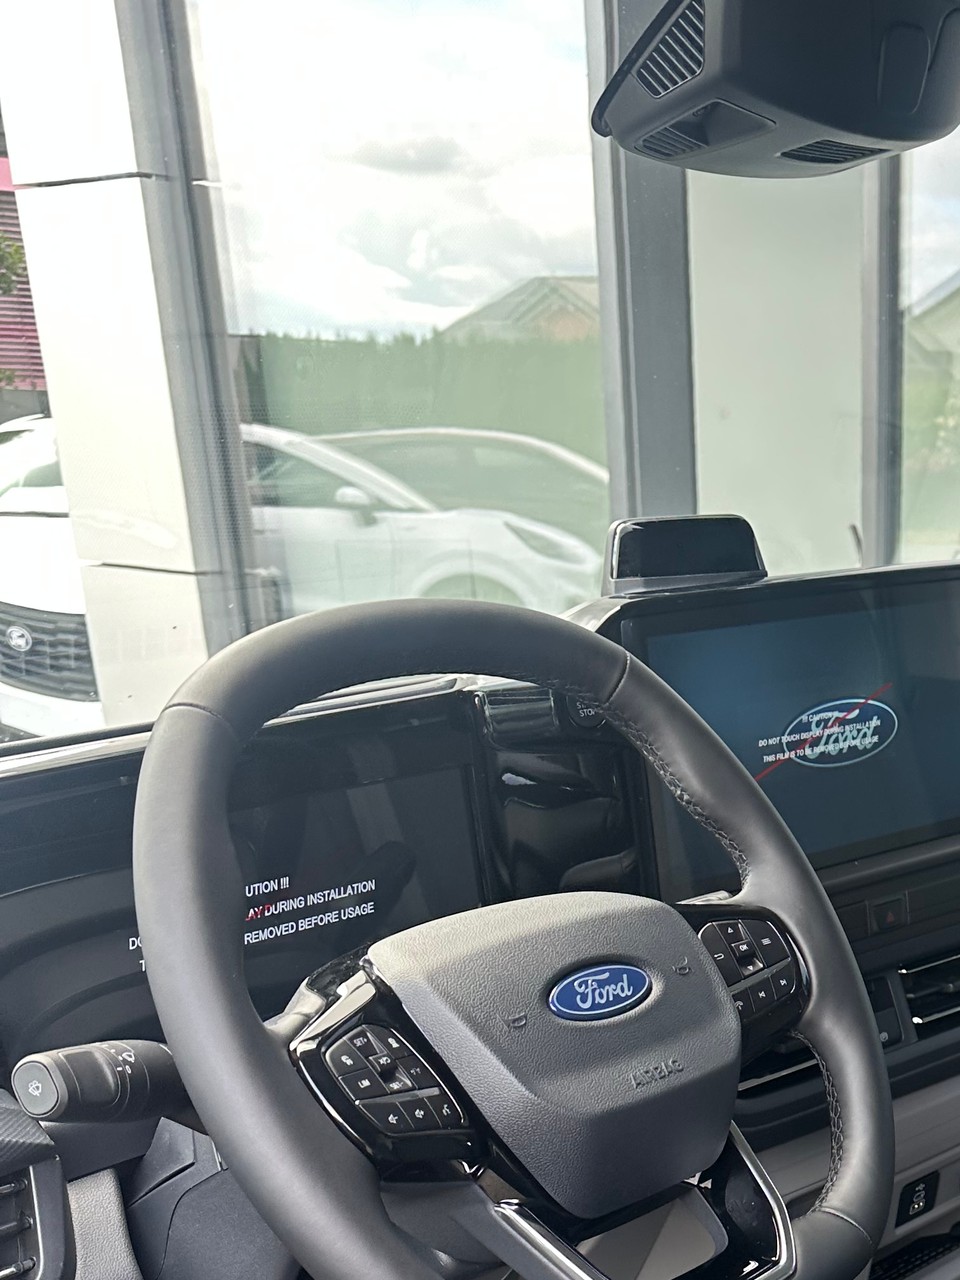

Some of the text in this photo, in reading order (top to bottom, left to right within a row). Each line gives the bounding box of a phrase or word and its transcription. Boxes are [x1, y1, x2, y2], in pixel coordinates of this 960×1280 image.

[758, 739, 768, 747] DO
[769, 737, 780, 745] NOT
[781, 734, 800, 743] TOUCH
[763, 754, 776, 762] THIS
[776, 751, 790, 760] FILM
[245, 879, 278, 897] UTION
[264, 896, 305, 917] DURING
[307, 879, 376, 906] INSTALLATION
[244, 902, 375, 945] REMOVED BEFORE USAGE
[573, 972, 633, 1009] Ford
[628, 1058, 685, 1090] AIRBAG
